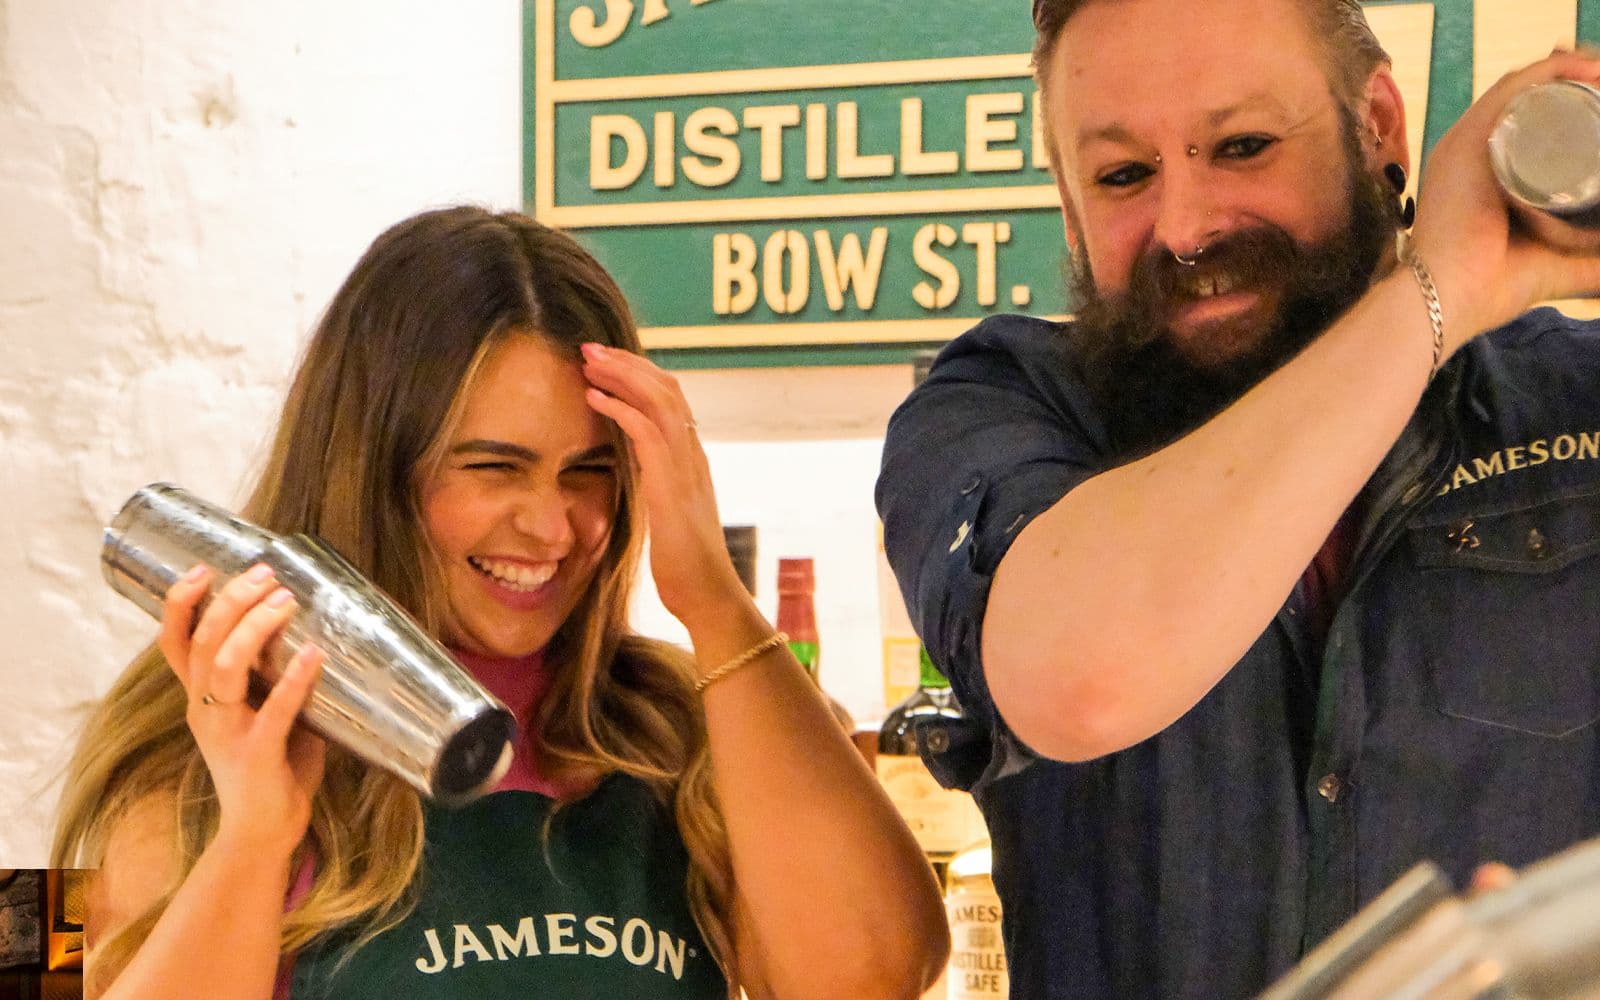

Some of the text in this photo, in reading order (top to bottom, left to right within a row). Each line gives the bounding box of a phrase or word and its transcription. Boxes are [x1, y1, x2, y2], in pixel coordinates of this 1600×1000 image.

[712, 221, 1031, 315] BOW ST.
[415, 913, 686, 981] JAMESON
